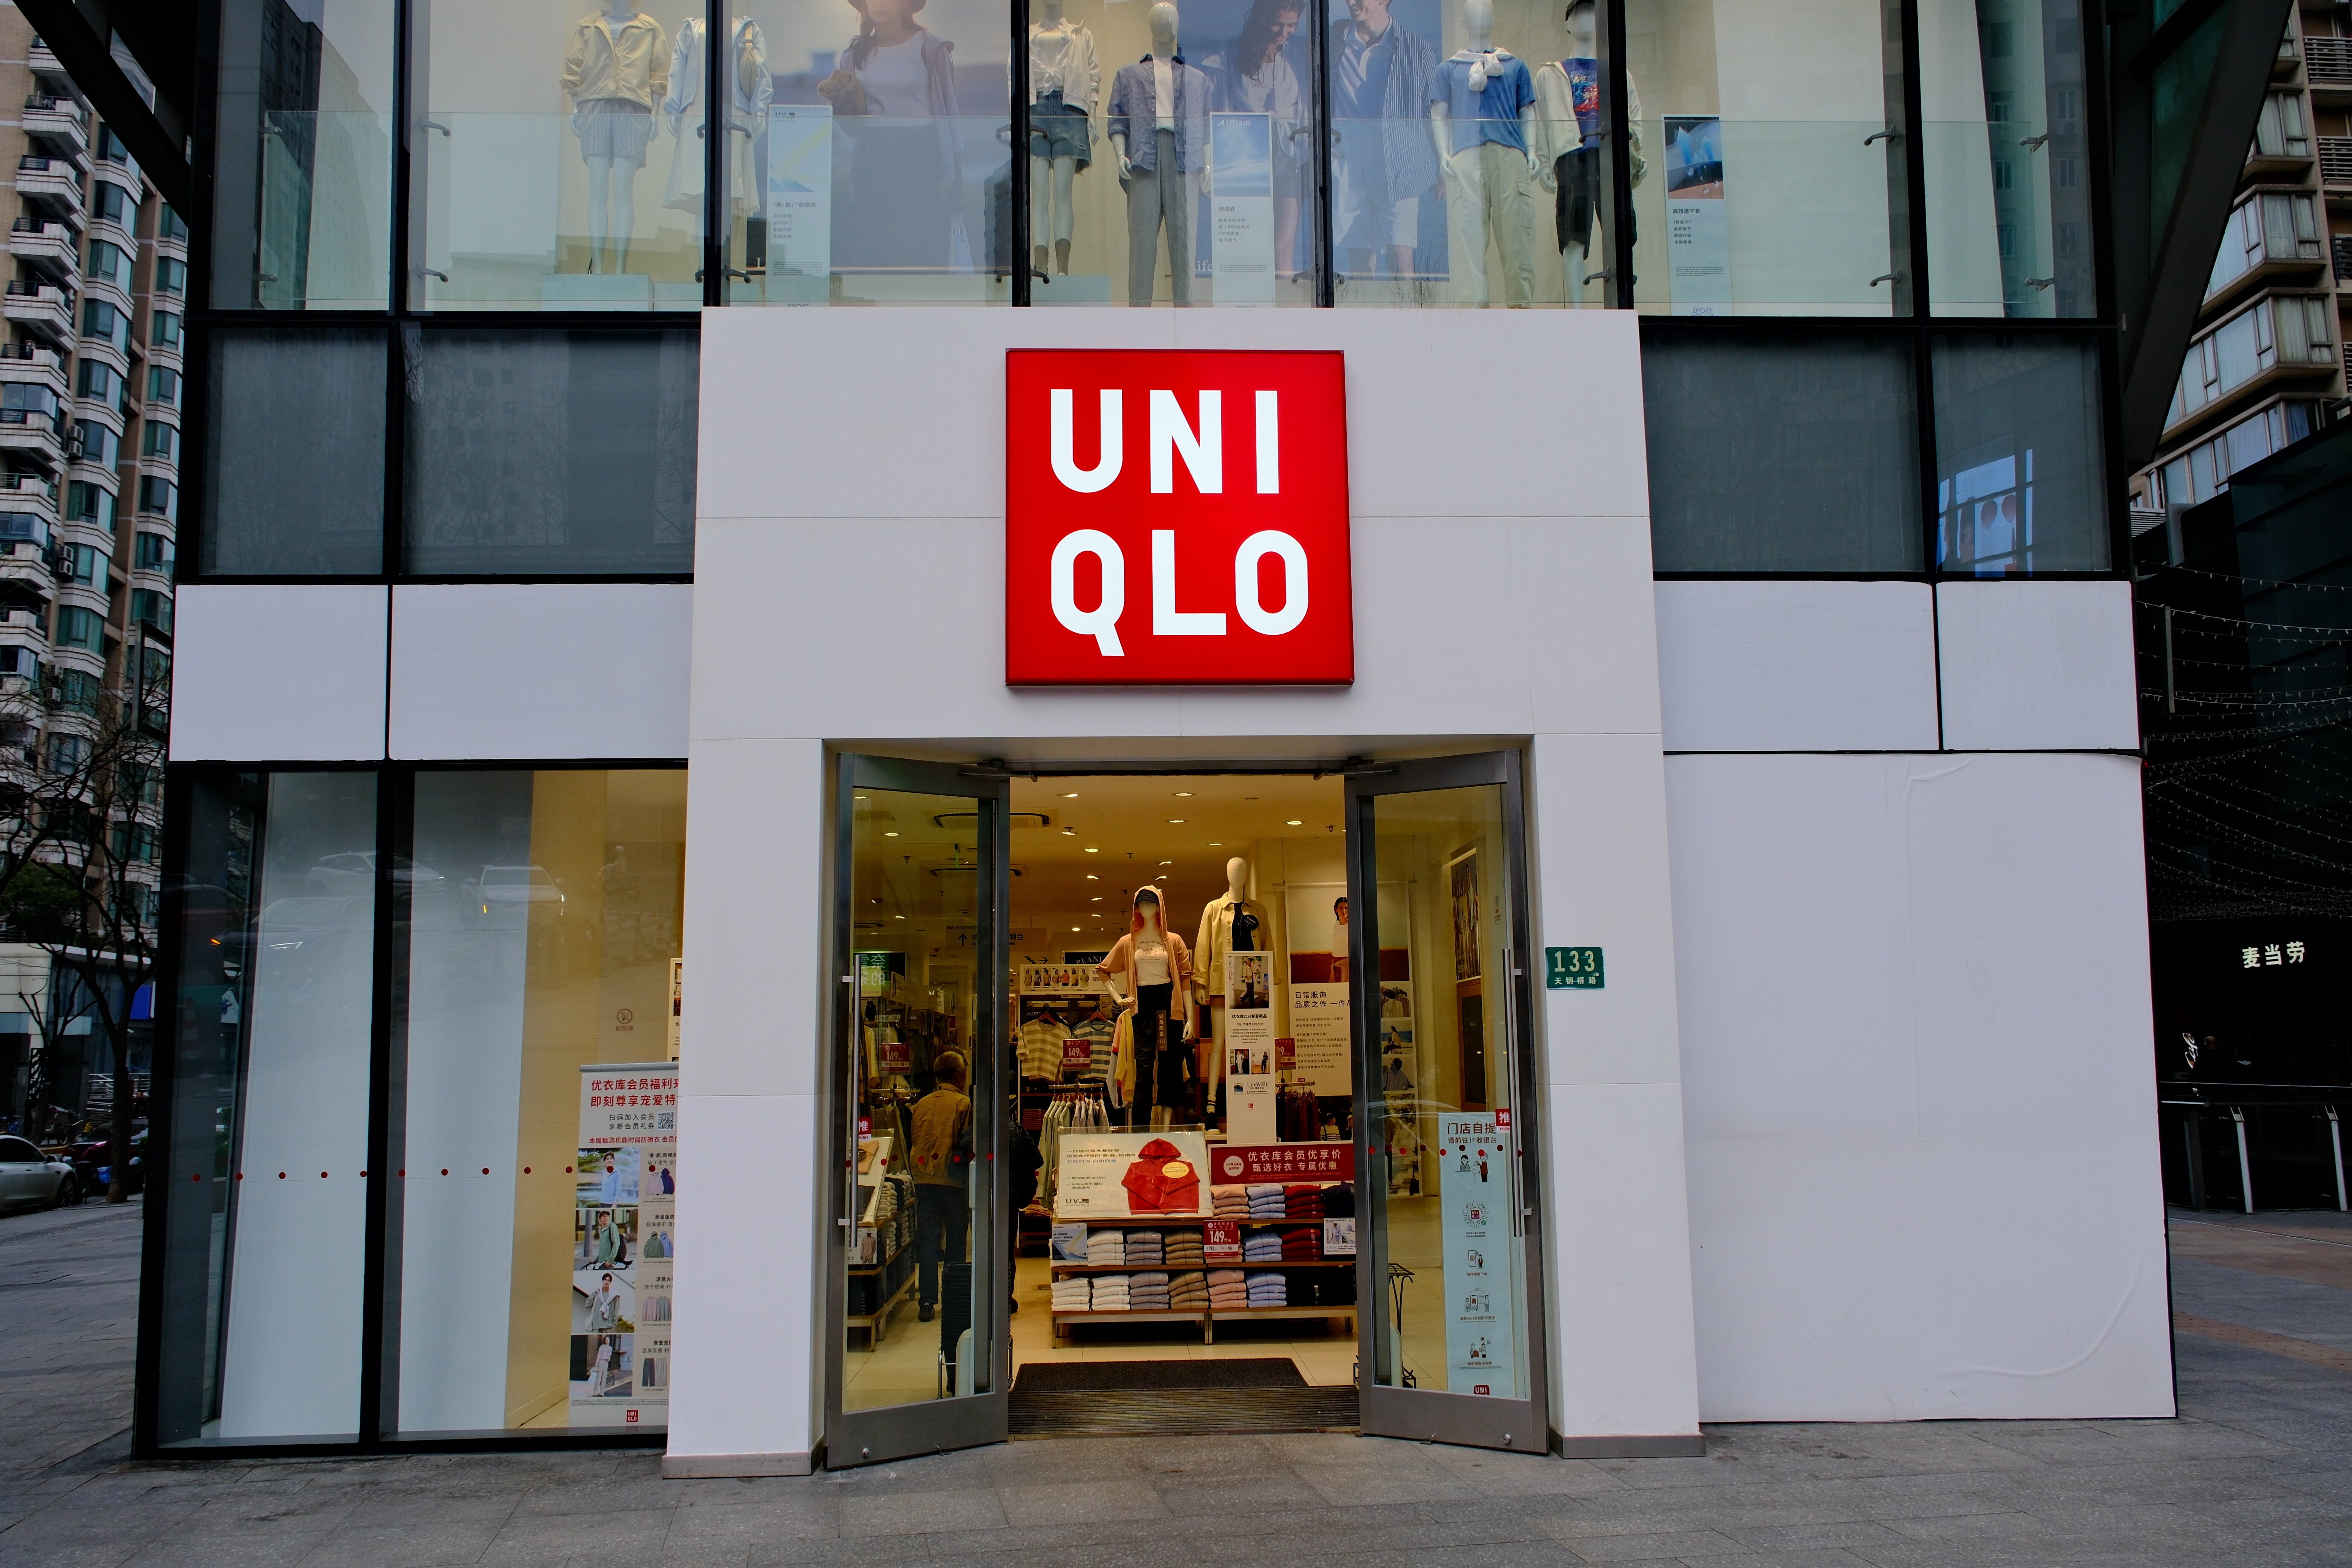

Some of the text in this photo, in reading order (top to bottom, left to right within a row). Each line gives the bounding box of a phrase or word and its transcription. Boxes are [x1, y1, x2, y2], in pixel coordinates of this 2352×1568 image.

[1195, 260, 1212, 271] ife
[1050, 389, 1279, 494] UNI
[1051, 529, 1309, 656] QLO
[2242, 941, 2305, 968] 麦当劳
[1554, 951, 1595, 972] 133
[591, 1094, 678, 1107] 即刻尊享宠爱特
[1499, 1112, 1510, 1123] 推
[1447, 1122, 1496, 1135] 门店自提
[1248, 1149, 1341, 1162] 优衣库会员优享价
[1253, 1161, 1337, 1172] 甄选好衣 专属优惠
